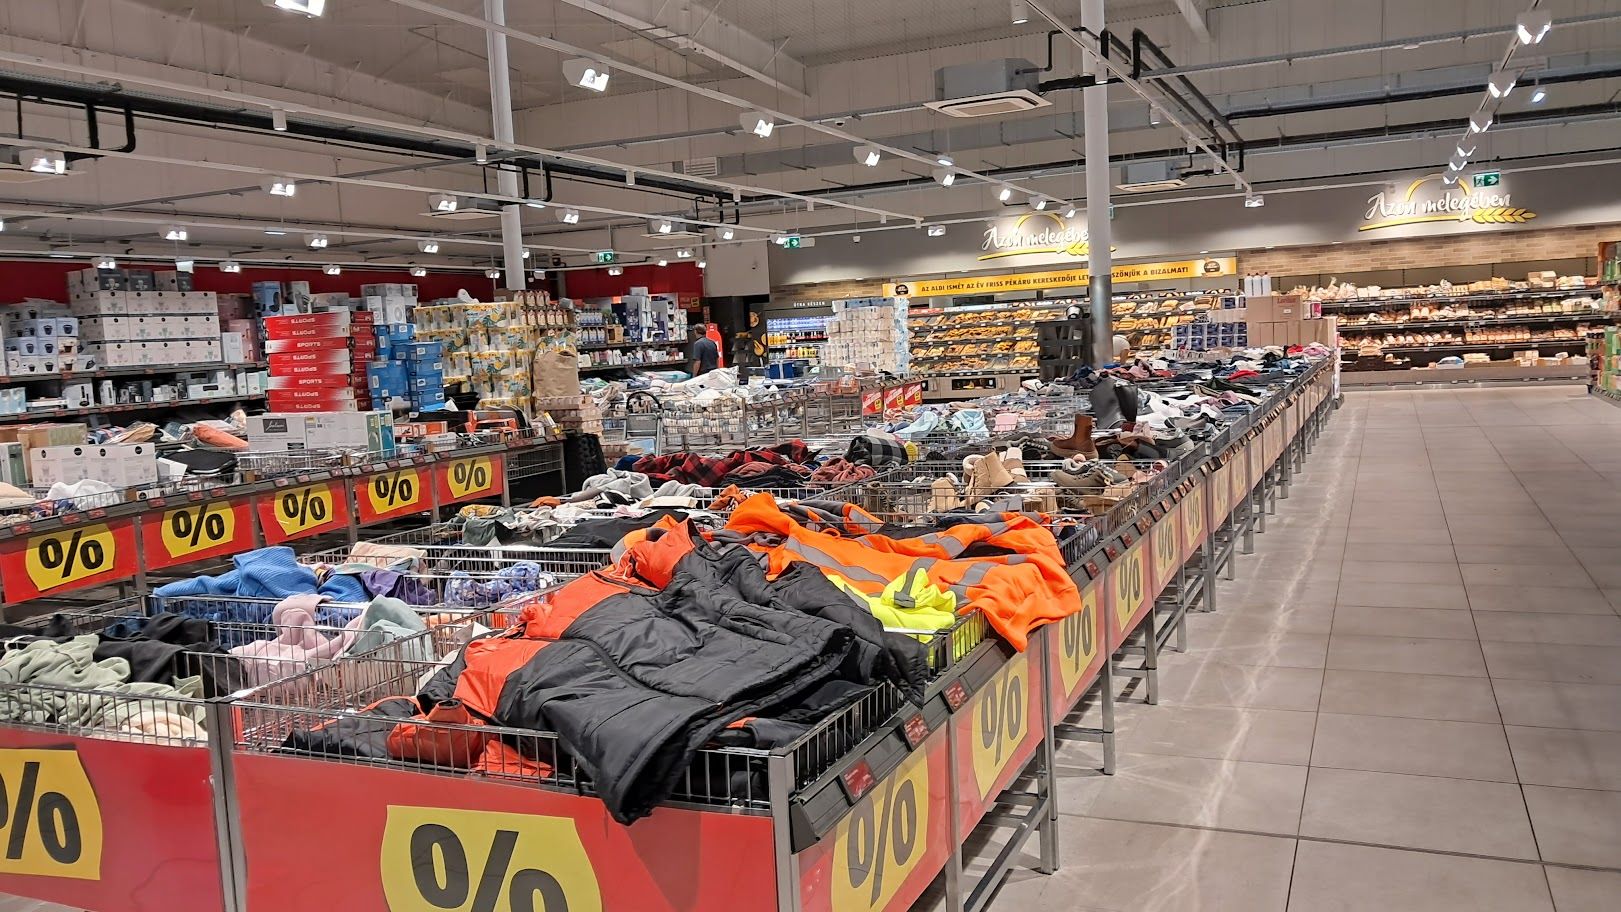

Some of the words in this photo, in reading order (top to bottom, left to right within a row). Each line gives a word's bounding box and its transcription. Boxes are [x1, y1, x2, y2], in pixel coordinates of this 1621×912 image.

[1364, 192, 1417, 219] Azon
[1422, 192, 1511, 222] melegében
[1026, 226, 1089, 254] melegébe
[946, 282, 964, 290] ISMÉT
[976, 280, 984, 288] ÉV
[1005, 278, 1031, 286] PÉKÁRU
[1033, 274, 1076, 284] KERESKEDŐJE
[1111, 268, 1141, 278] SZÖNJÜK
[1150, 266, 1188, 276] BIZALMAT!
[375, 470, 412, 506] %
[453, 459, 486, 491] %
[172, 503, 225, 547] %
[282, 487, 326, 527] %
[38, 530, 105, 578] %
[1158, 519, 1174, 568] %
[1120, 551, 1140, 613] %
[1063, 603, 1092, 674] %
[980, 670, 1022, 767] %
[0, 761, 82, 865] %
[847, 768, 916, 908] %
[409, 822, 569, 912] %
